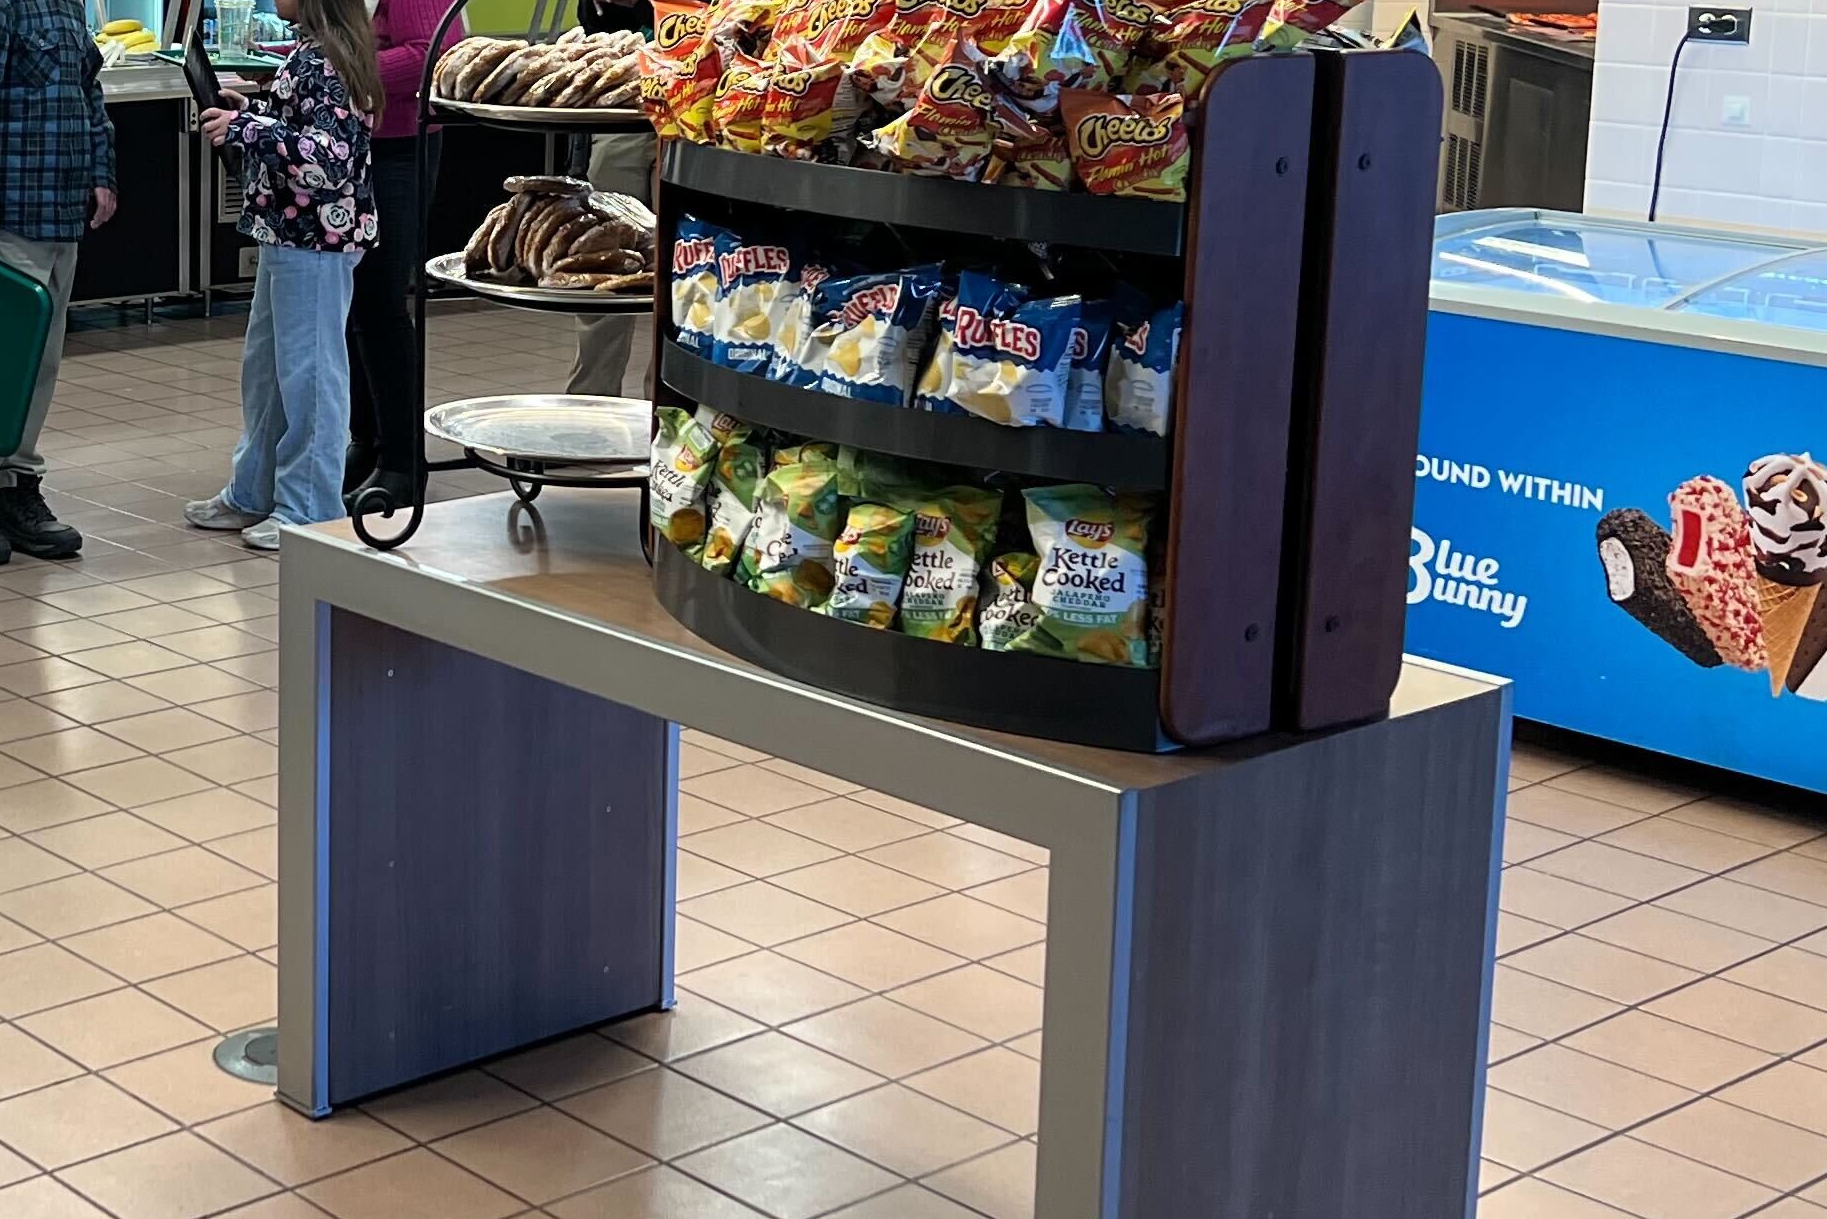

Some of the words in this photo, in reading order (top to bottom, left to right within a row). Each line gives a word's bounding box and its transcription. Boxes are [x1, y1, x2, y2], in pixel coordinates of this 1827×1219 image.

[657, 13, 709, 50] Chee
[930, 65, 995, 109] Chee
[1078, 115, 1171, 159] Cheetos
[1139, 145, 1170, 167] Hot
[1416, 454, 1491, 489] OUND
[1497, 469, 1604, 512] WITHIN
[1052, 547, 1119, 571] Kettle
[905, 570, 954, 591] ooked
[1042, 568, 1126, 594] Cooked
[1052, 595, 1107, 609] CHEDDAR
[1063, 612, 1094, 624] LESS
[1096, 614, 1118, 624] FAT
